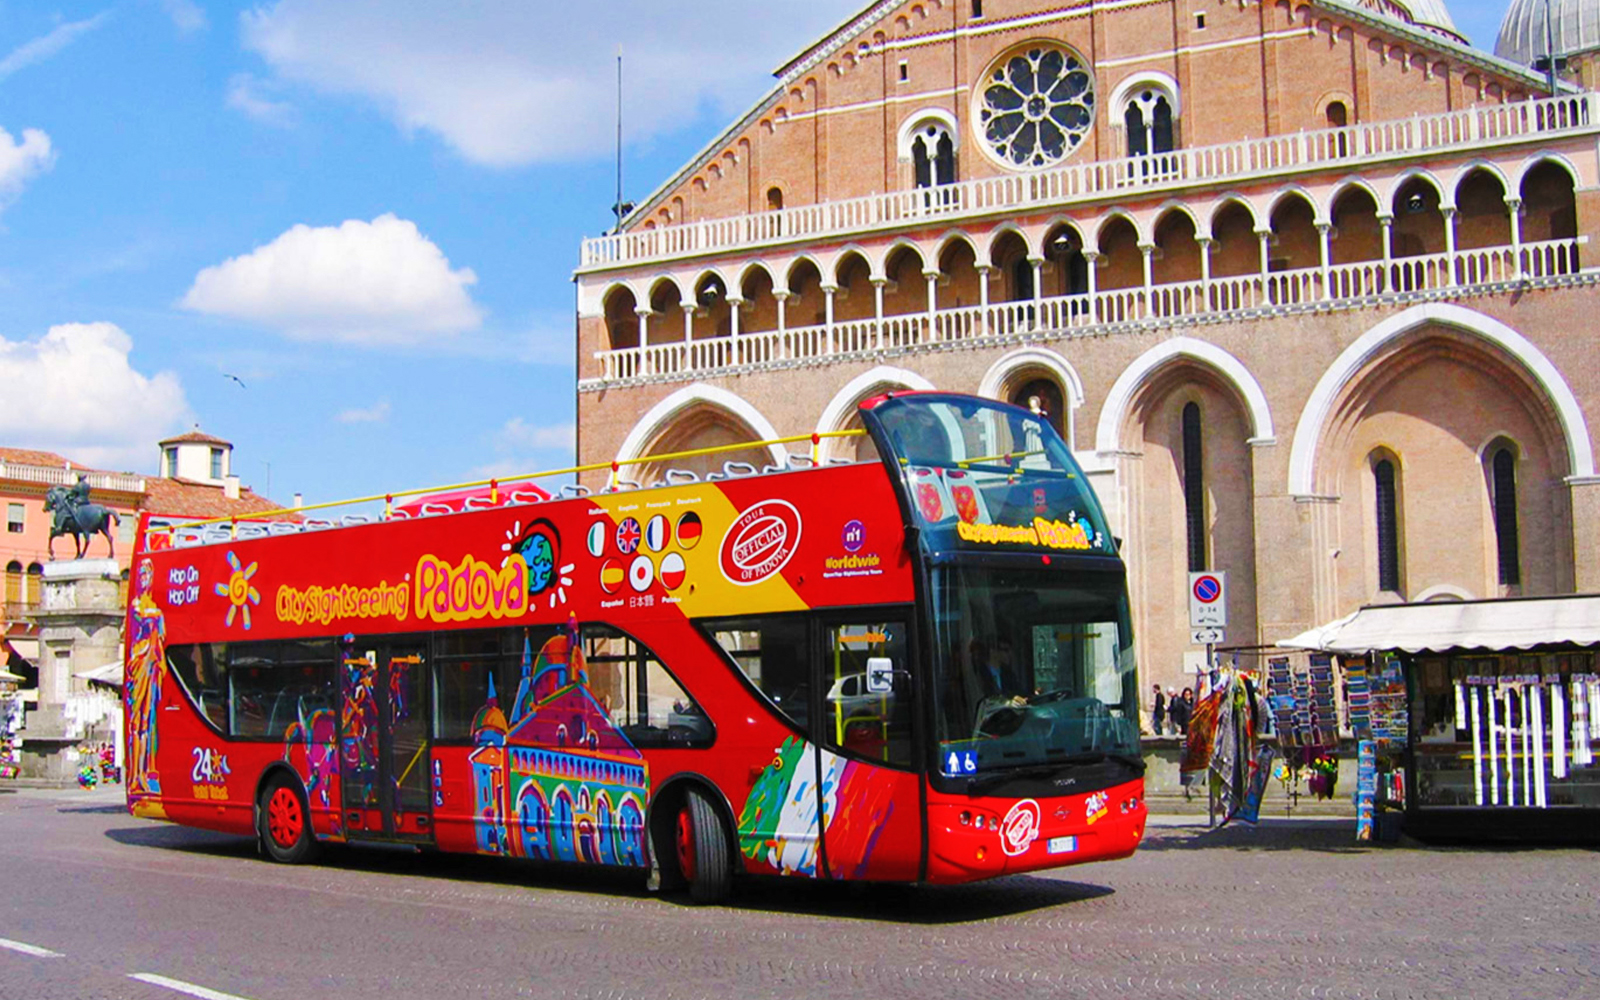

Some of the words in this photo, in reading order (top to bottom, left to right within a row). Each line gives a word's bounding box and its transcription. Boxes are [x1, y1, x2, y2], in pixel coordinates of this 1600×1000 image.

[739, 508, 765, 528] TOUR
[735, 525, 785, 561] OFFICIAL
[169, 568, 186, 585] Hop
[187, 565, 199, 583] On
[741, 569, 753, 580] OF
[754, 547, 789, 577] PADOVA
[168, 589, 185, 606] Hop
[186, 585, 200, 603] Off
[415, 554, 528, 623] Padova
[630, 594, 654, 608] 日本語
[192, 746, 213, 782] 24
